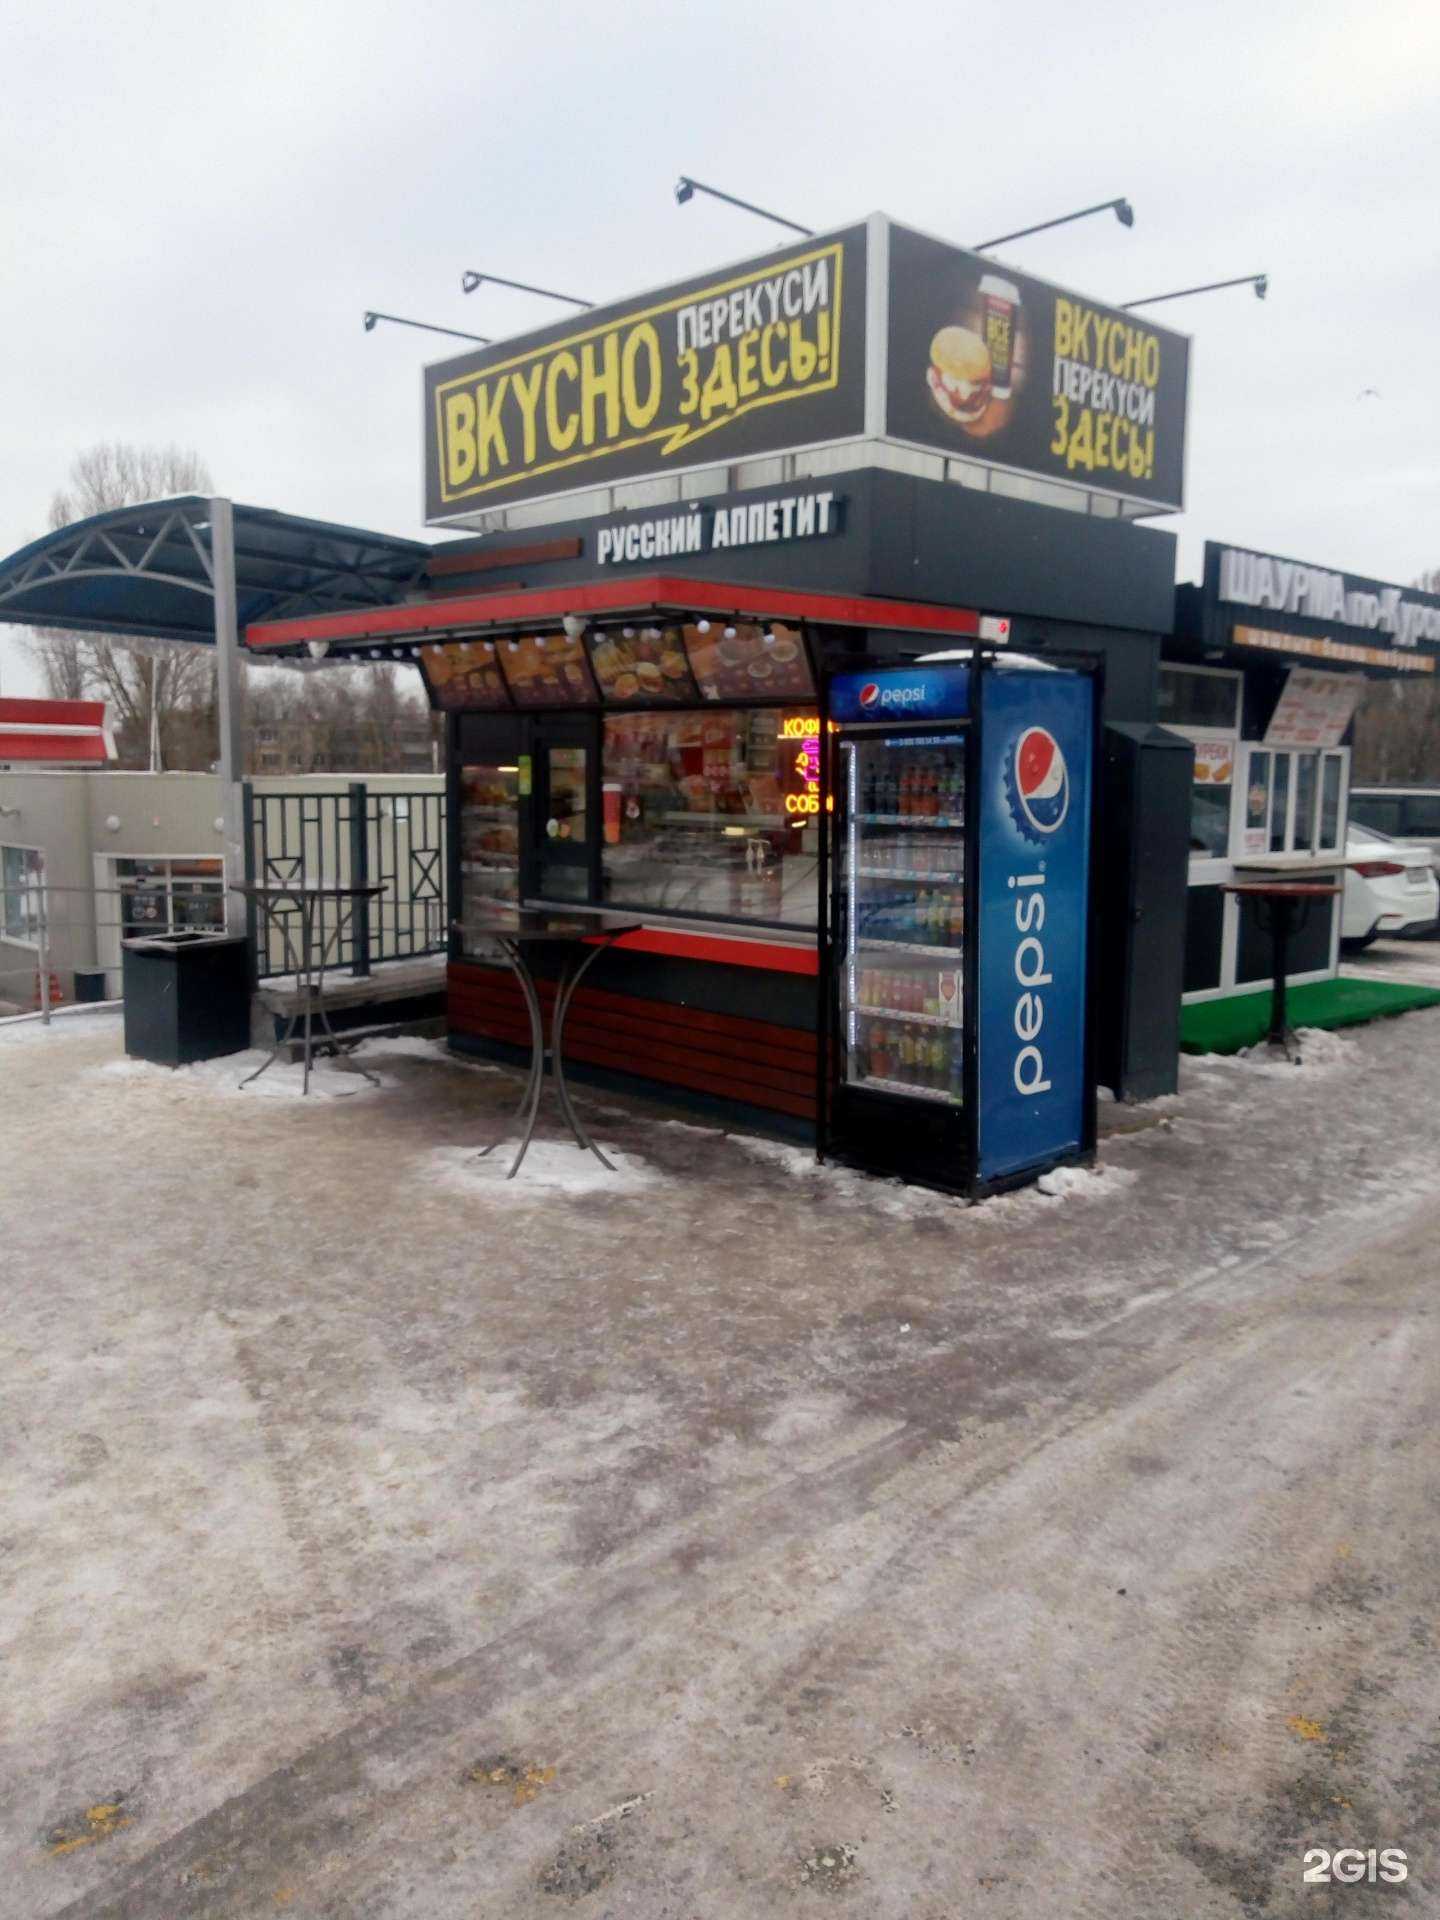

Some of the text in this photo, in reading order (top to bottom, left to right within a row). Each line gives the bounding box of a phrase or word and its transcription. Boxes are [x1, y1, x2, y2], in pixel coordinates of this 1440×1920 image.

[677, 260, 829, 354] ПЕРЕКУСИ
[1054, 298, 1160, 388] ВКУСНО
[445, 320, 662, 486] ВКУСНО
[677, 310, 829, 420] ЗДЕСЬ!
[1053, 356, 1155, 425] ПЕРЕКУСИ
[1050, 396, 1155, 480] ЗДЕСЬ!
[598, 492, 834, 565] РУССКИЙ АППЕТИТ
[1218, 549, 1346, 624] ШАУРМА
[880, 685, 926, 706] pepsi
[1007, 873, 1053, 1096] pepsi
